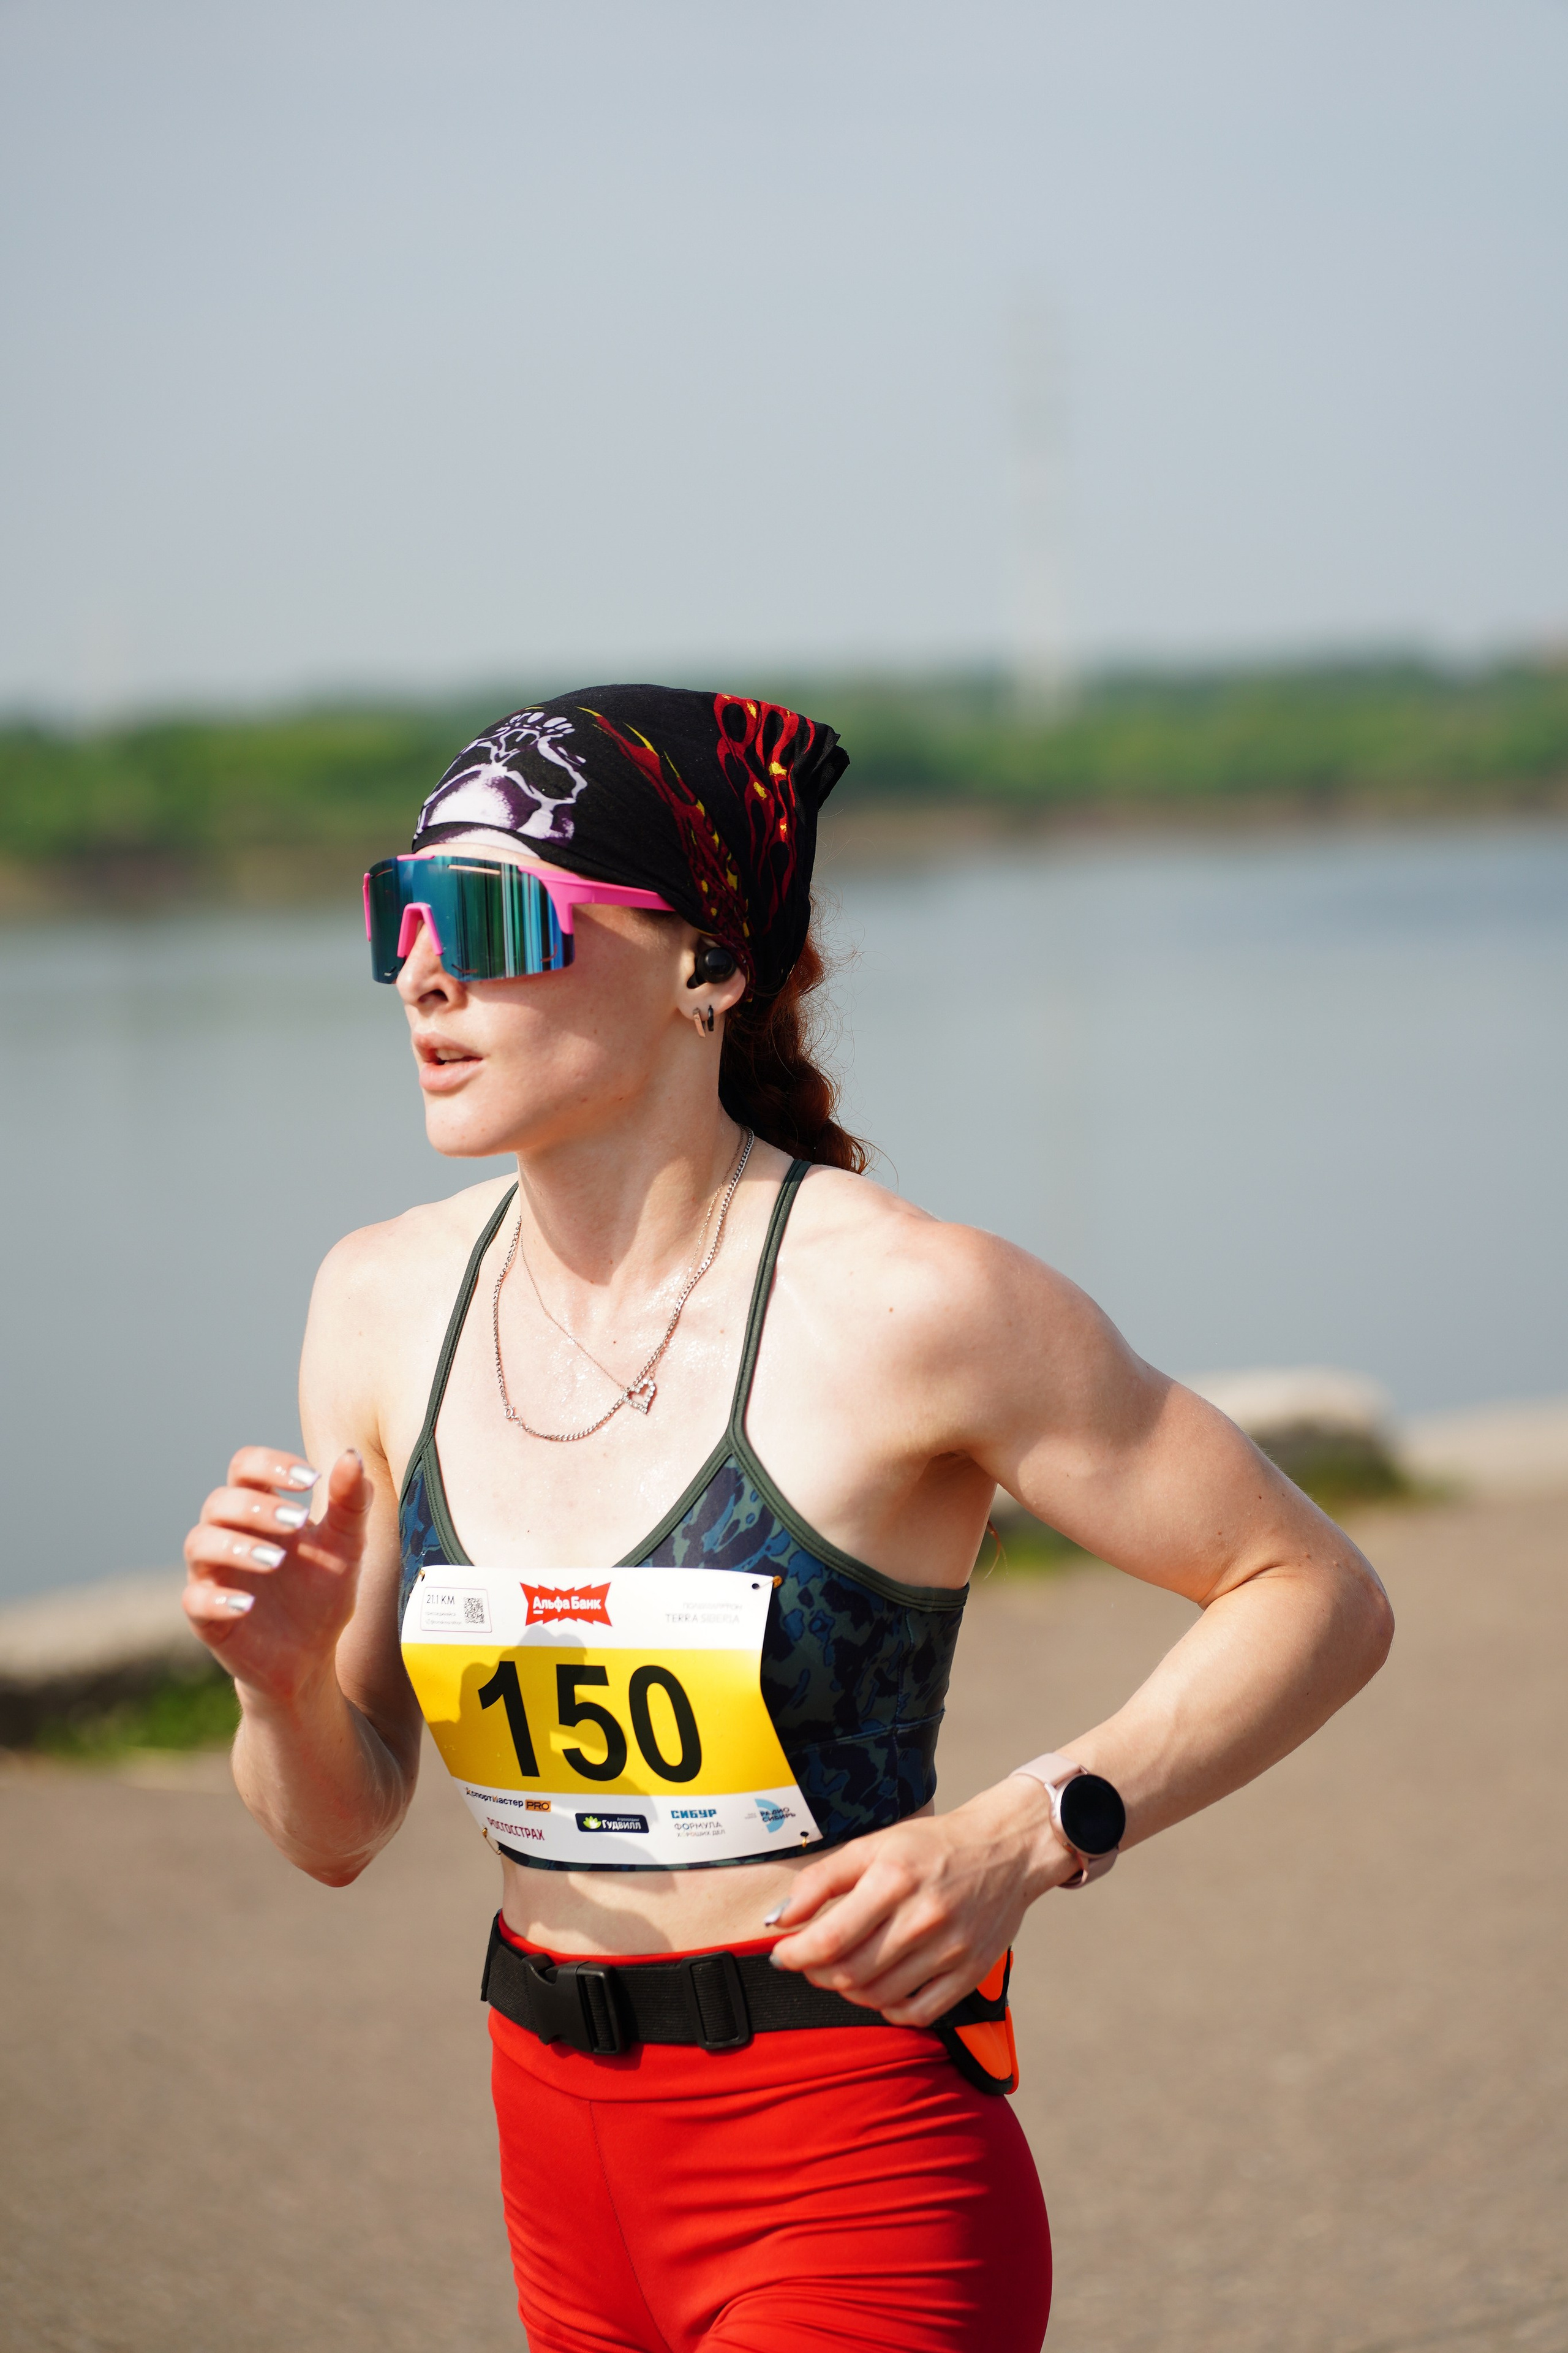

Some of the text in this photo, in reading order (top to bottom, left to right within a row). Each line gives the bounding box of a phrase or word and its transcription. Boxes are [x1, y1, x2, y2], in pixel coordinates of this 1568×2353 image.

[426, 1594, 439, 1604] 21.1
[533, 1595, 601, 1614] Альфа Банк
[665, 1613, 740, 1624] TERRA SIBERIA
[477, 1660, 703, 1784] 150
[526, 1800, 550, 1810] PRO
[671, 1809, 717, 1819] СИБУР
[760, 1807, 790, 1816] РАДИО
[763, 1813, 796, 1822] СИБИРЬ
[486, 1816, 545, 1841] РОСГОССТРАХ
[674, 1821, 723, 1830] ФОРМУЛА
